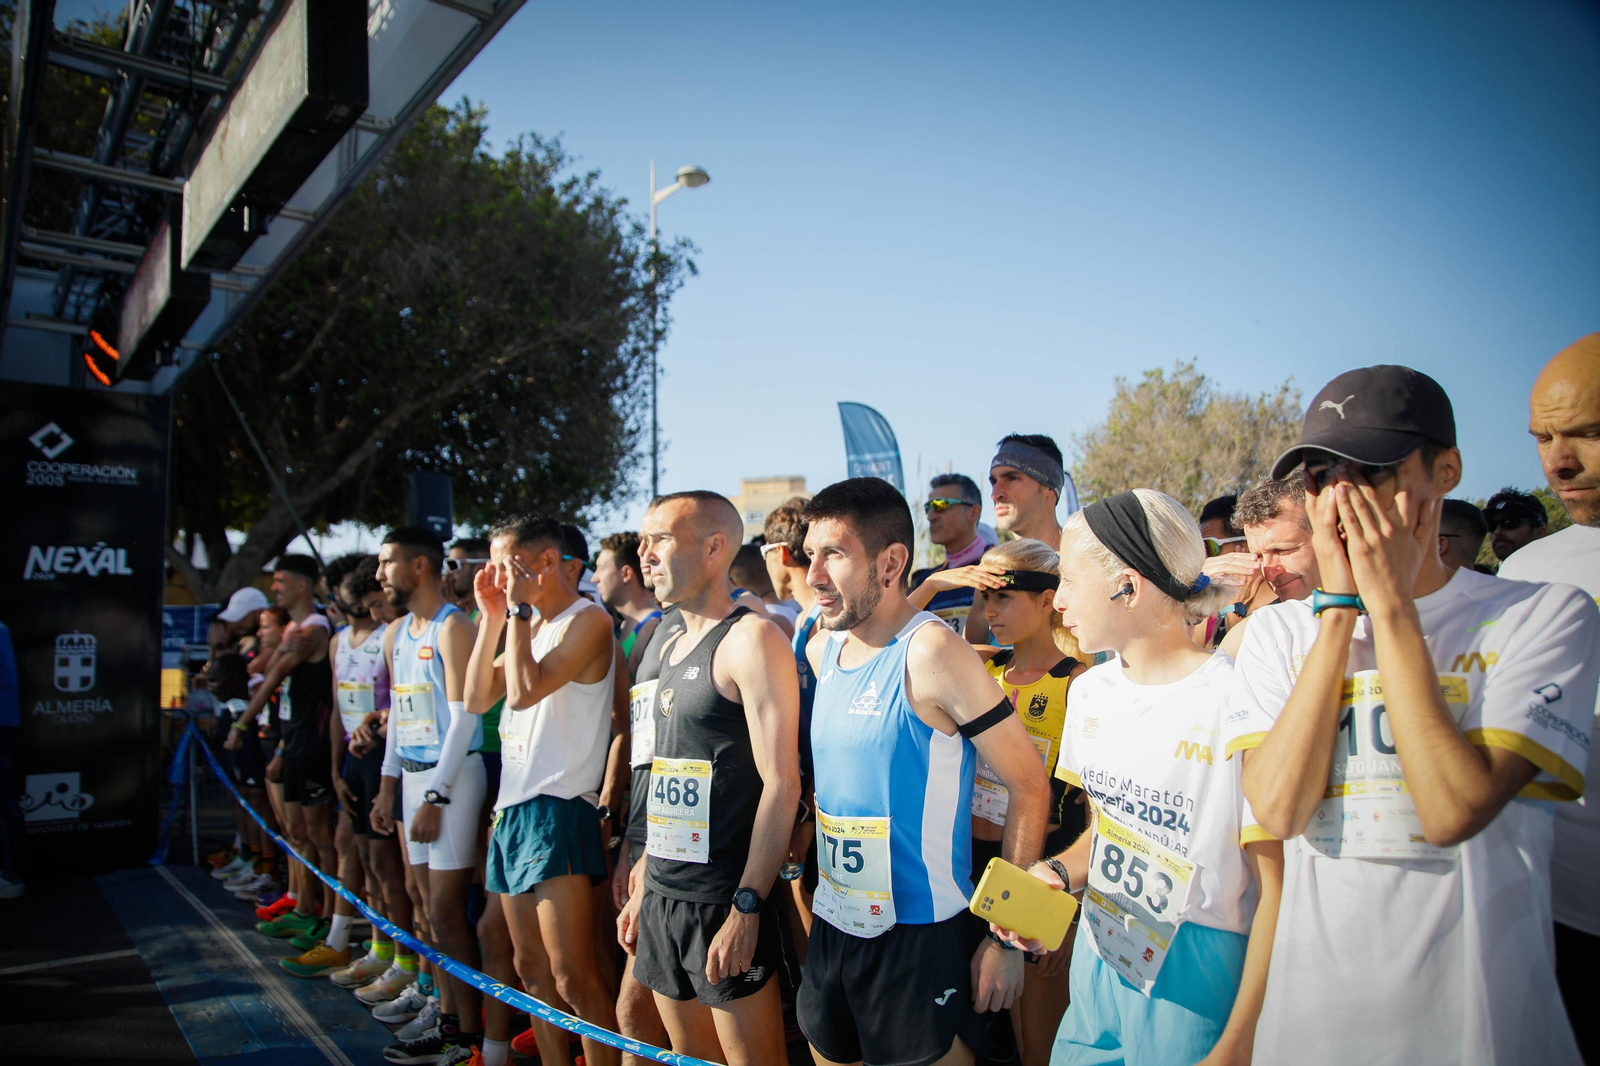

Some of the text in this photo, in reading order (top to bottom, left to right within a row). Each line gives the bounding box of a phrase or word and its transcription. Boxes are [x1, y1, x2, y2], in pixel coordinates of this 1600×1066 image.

[26, 460, 138, 479] COOPERACIÓN
[26, 472, 66, 487] 2005
[22, 541, 134, 580] NEXAL
[33, 698, 114, 715] ALMERÍA
[347, 691, 355, 705] 4
[398, 695, 414, 713] 11
[650, 774, 700, 807] 1468
[1120, 776, 1194, 813] Maratón
[1137, 800, 1190, 836] 2024
[1132, 841, 1151, 856] 2024
[1090, 832, 1174, 914] 1853
